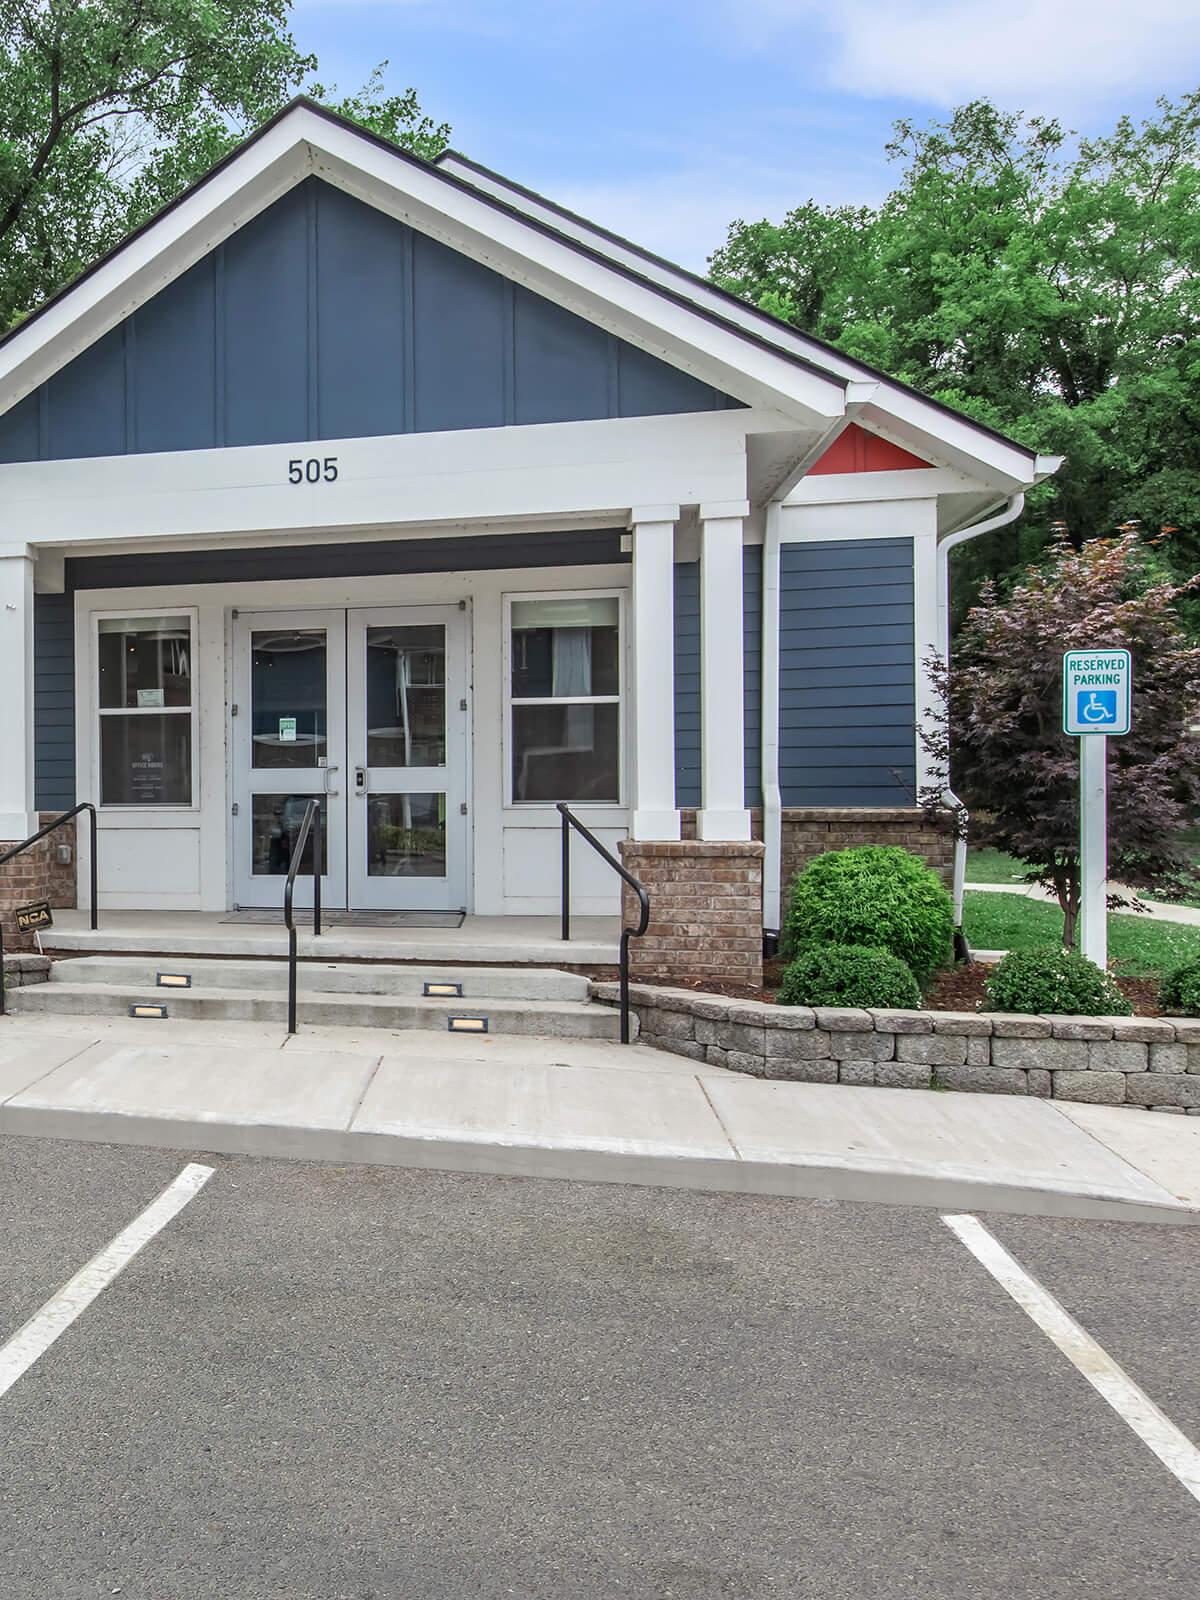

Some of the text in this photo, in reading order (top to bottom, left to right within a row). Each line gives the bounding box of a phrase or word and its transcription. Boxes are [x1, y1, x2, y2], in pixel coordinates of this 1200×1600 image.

[288, 457, 338, 484] 505
[1070, 659, 1125, 671] RESERVED
[1074, 674, 1121, 685] PARKING
